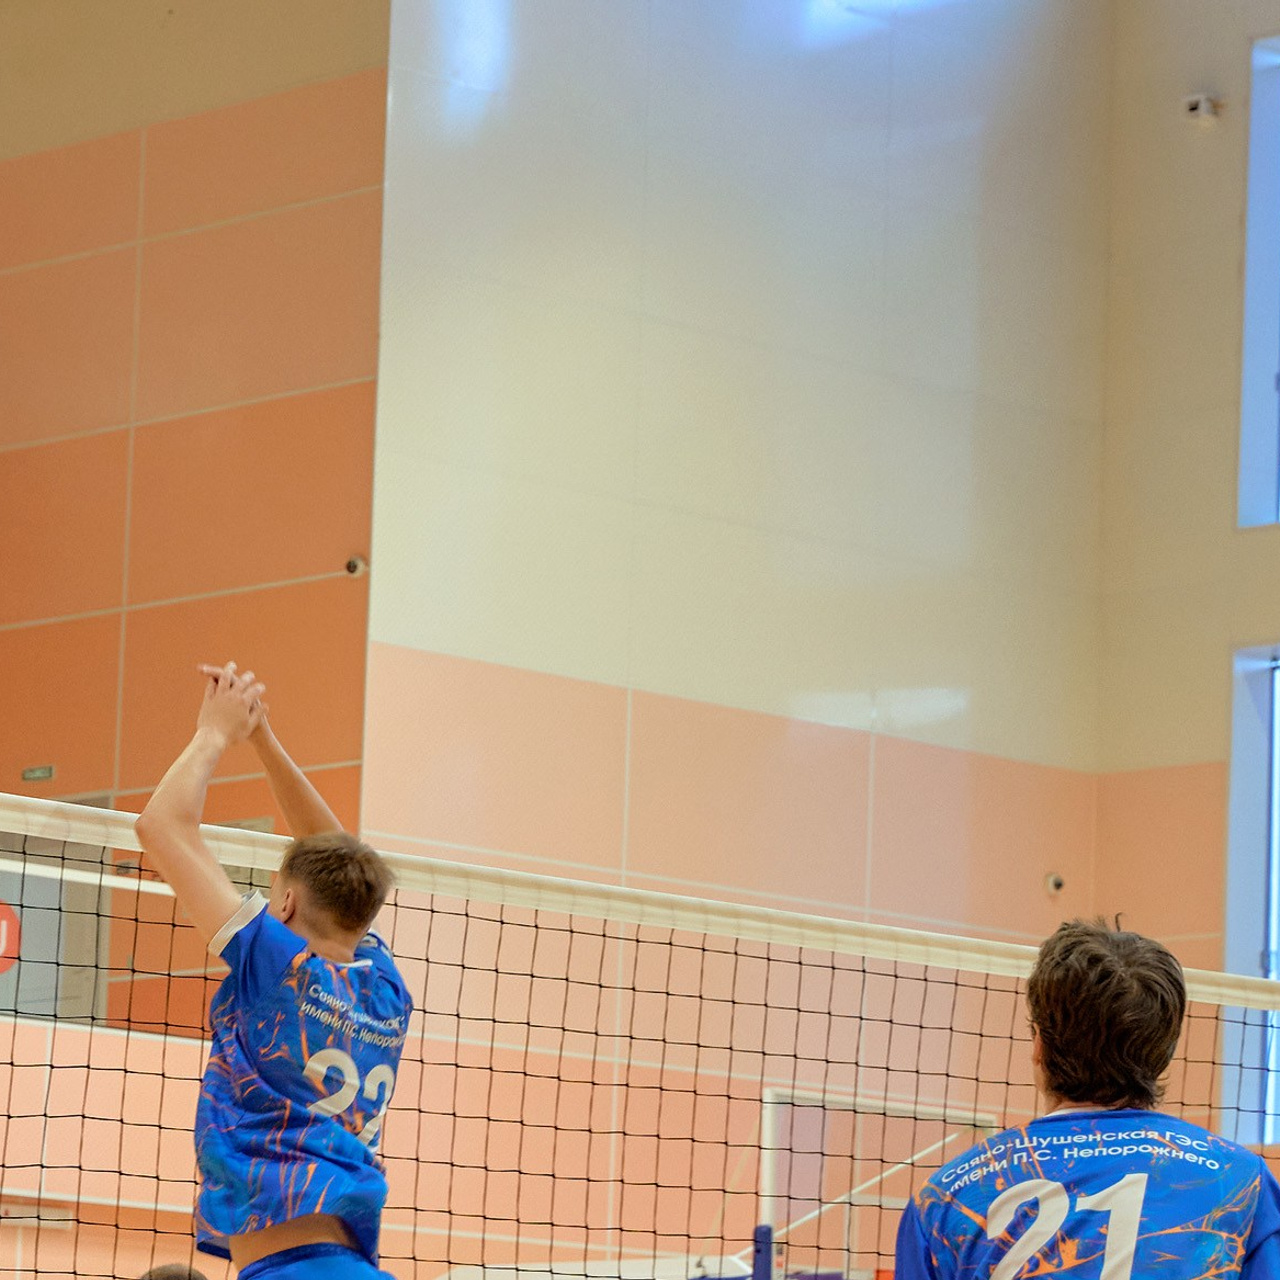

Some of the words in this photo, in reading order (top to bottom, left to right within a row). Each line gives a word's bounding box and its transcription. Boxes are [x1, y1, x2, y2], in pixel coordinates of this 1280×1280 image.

[302, 1048, 395, 1153] 22
[940, 1129, 1159, 1184] Саяно-Шушенская
[1164, 1131, 1210, 1152] ГЭС
[1013, 1148, 1058, 1166] П.С.
[1063, 1144, 1220, 1171] Непорожнего
